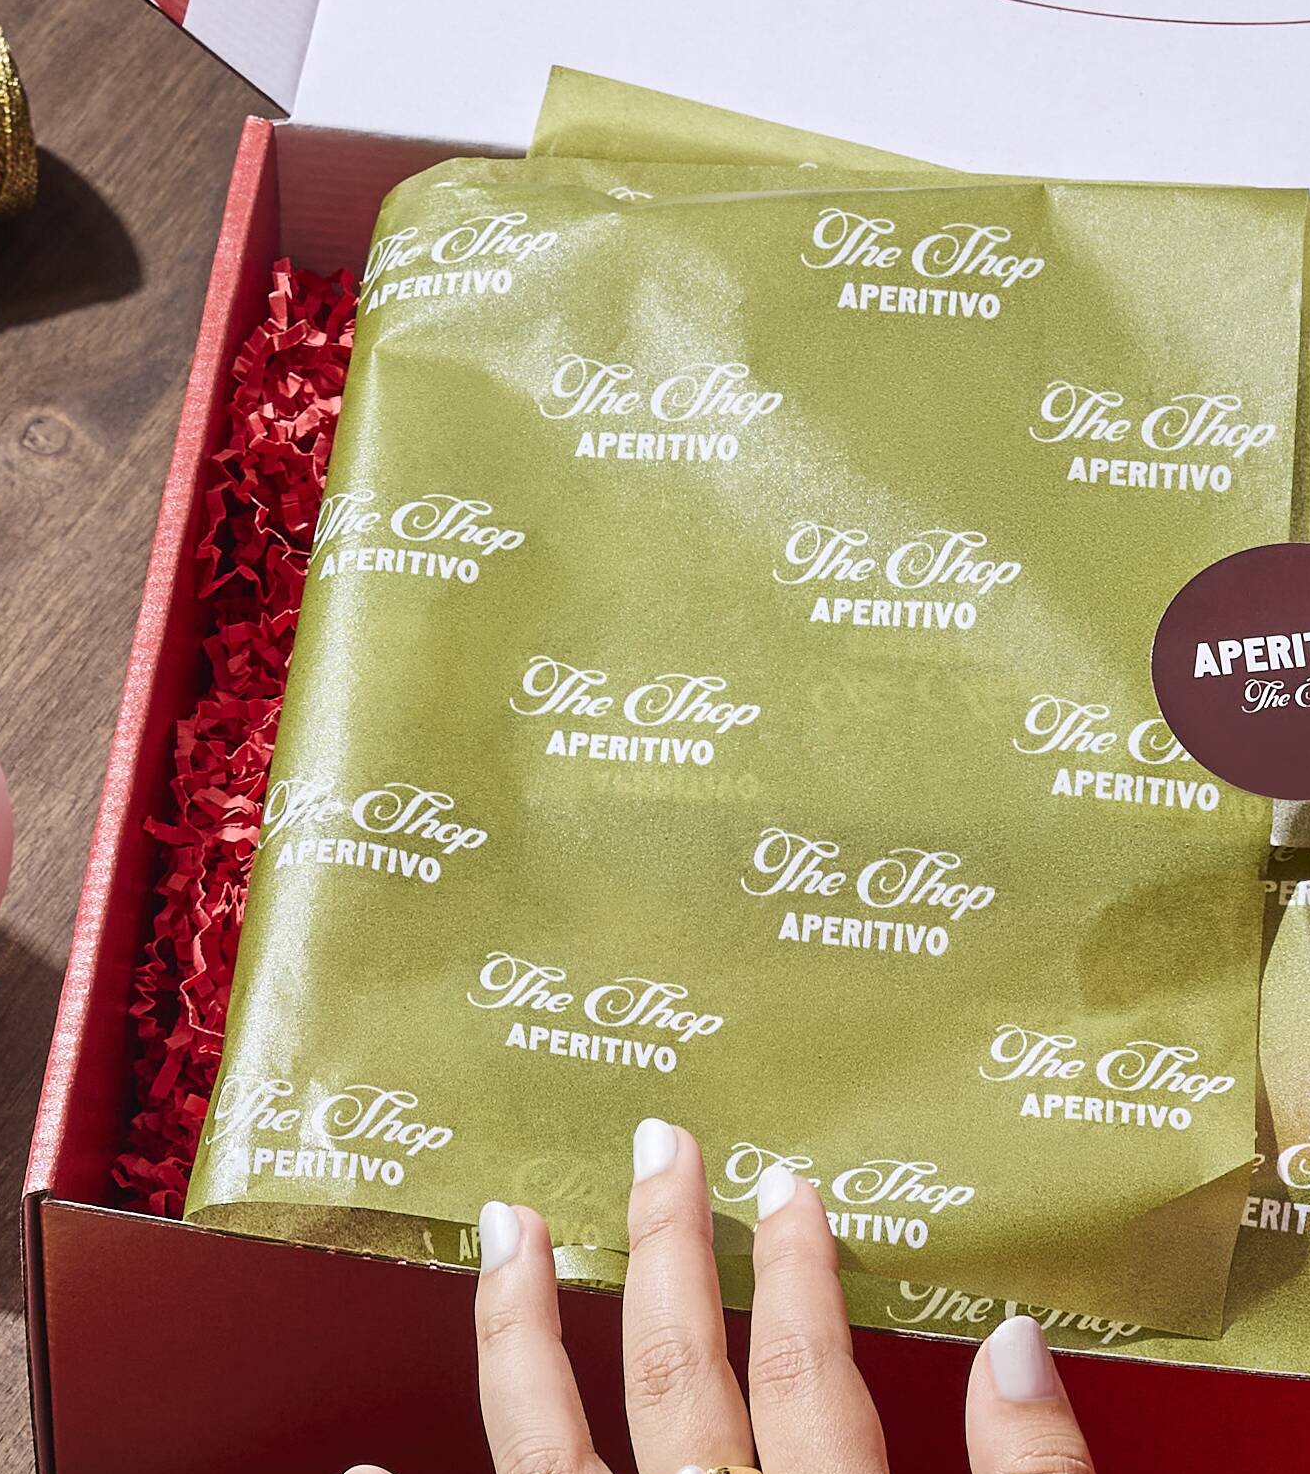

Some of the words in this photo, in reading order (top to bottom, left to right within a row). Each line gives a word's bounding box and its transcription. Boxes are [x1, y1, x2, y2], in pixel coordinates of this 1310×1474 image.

[431, 212, 558, 263] Shop
[801, 208, 901, 269] The
[910, 223, 1045, 287] Shop
[365, 270, 512, 314] APERITIVO
[838, 282, 1000, 319] APERITIVO
[539, 354, 638, 420] The
[651, 362, 784, 423] Shop
[1029, 381, 1131, 444] The
[1141, 394, 1276, 457] Shop
[575, 430, 738, 461] APERITIVO
[1067, 456, 1231, 492] APERITIVO
[390, 494, 526, 555] Shop
[319, 550, 479, 584] APERITIVO
[773, 521, 877, 585] The
[885, 529, 1022, 594] Shop
[810, 597, 976, 628] APERITIVO
[509, 655, 611, 716] The
[623, 673, 761, 733] Shop
[1242, 679, 1290, 713] The
[546, 731, 714, 766] APERITIVO
[1013, 694, 1117, 758] The
[1052, 769, 1219, 812] APERITIVO
[351, 782, 487, 855] Shop
[275, 839, 441, 883] APERITIVO
[741, 828, 847, 898] The
[857, 848, 995, 920] Shop
[778, 912, 948, 956] APERITIVO
[467, 952, 573, 1012] The
[584, 977, 724, 1043] Shop
[506, 1022, 677, 1073] APERITIVO
[978, 1024, 1084, 1082] The
[1096, 1041, 1235, 1102] Shop
[205, 1074, 299, 1145] The
[309, 1084, 454, 1156] Shop
[1020, 1093, 1192, 1130] APERITIVO
[229, 1147, 404, 1186] APERITIVO
[831, 1159, 976, 1214] Shop
